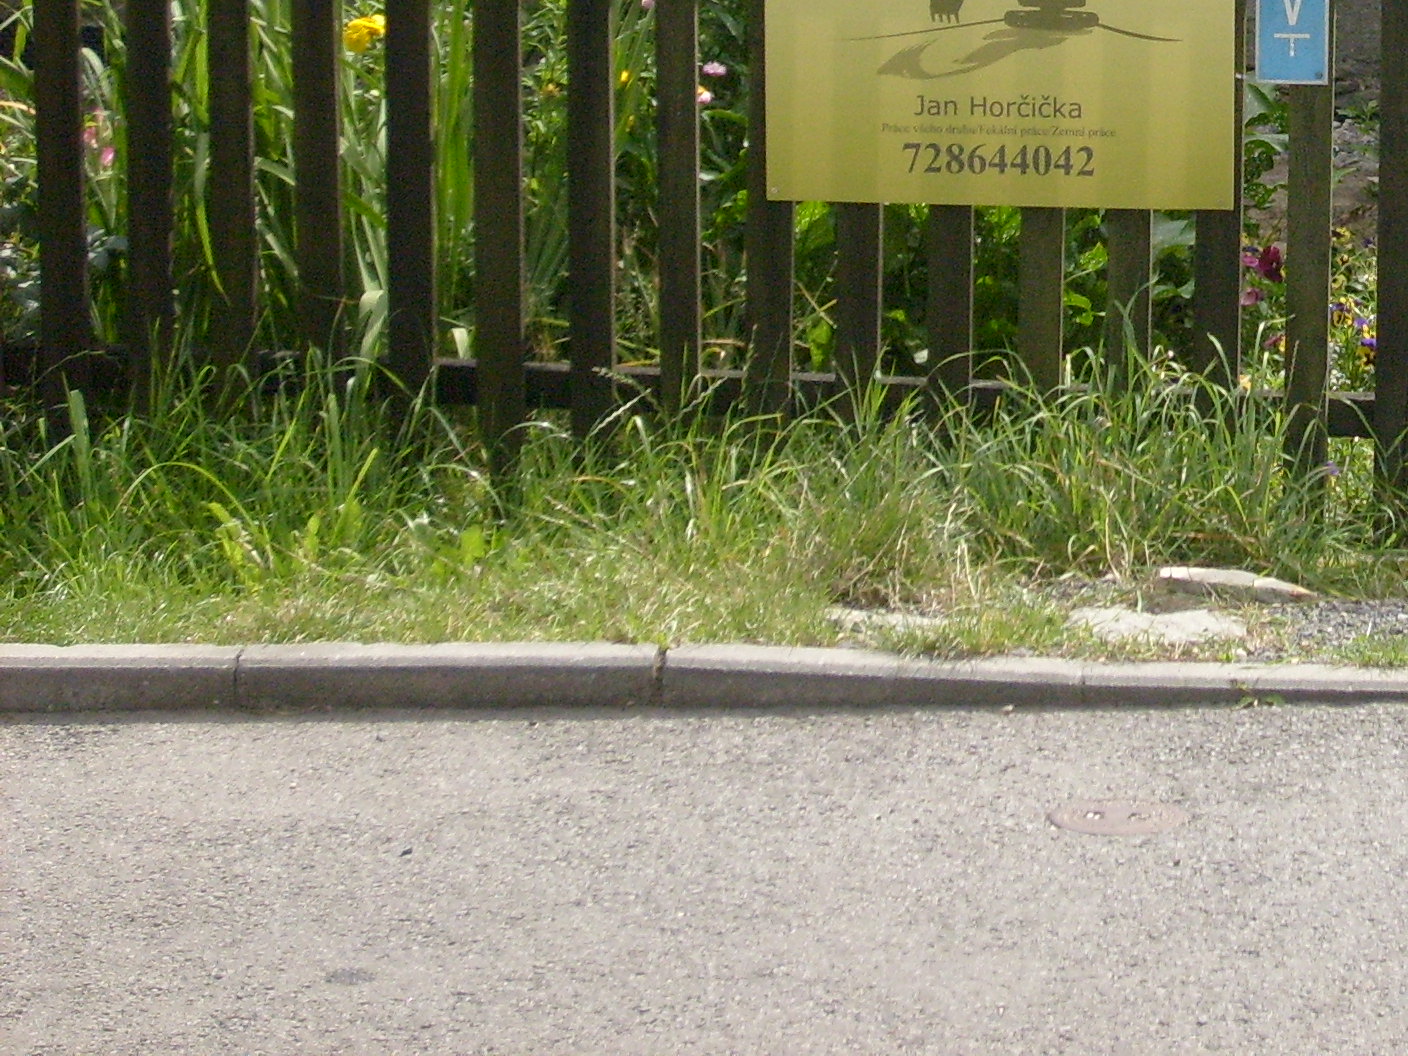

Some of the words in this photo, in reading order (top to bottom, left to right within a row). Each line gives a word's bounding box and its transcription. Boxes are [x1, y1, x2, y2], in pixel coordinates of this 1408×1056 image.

[913, 95, 958, 118] Jan
[970, 94, 1083, 120] Horčička
[902, 142, 1095, 178] 728644042
